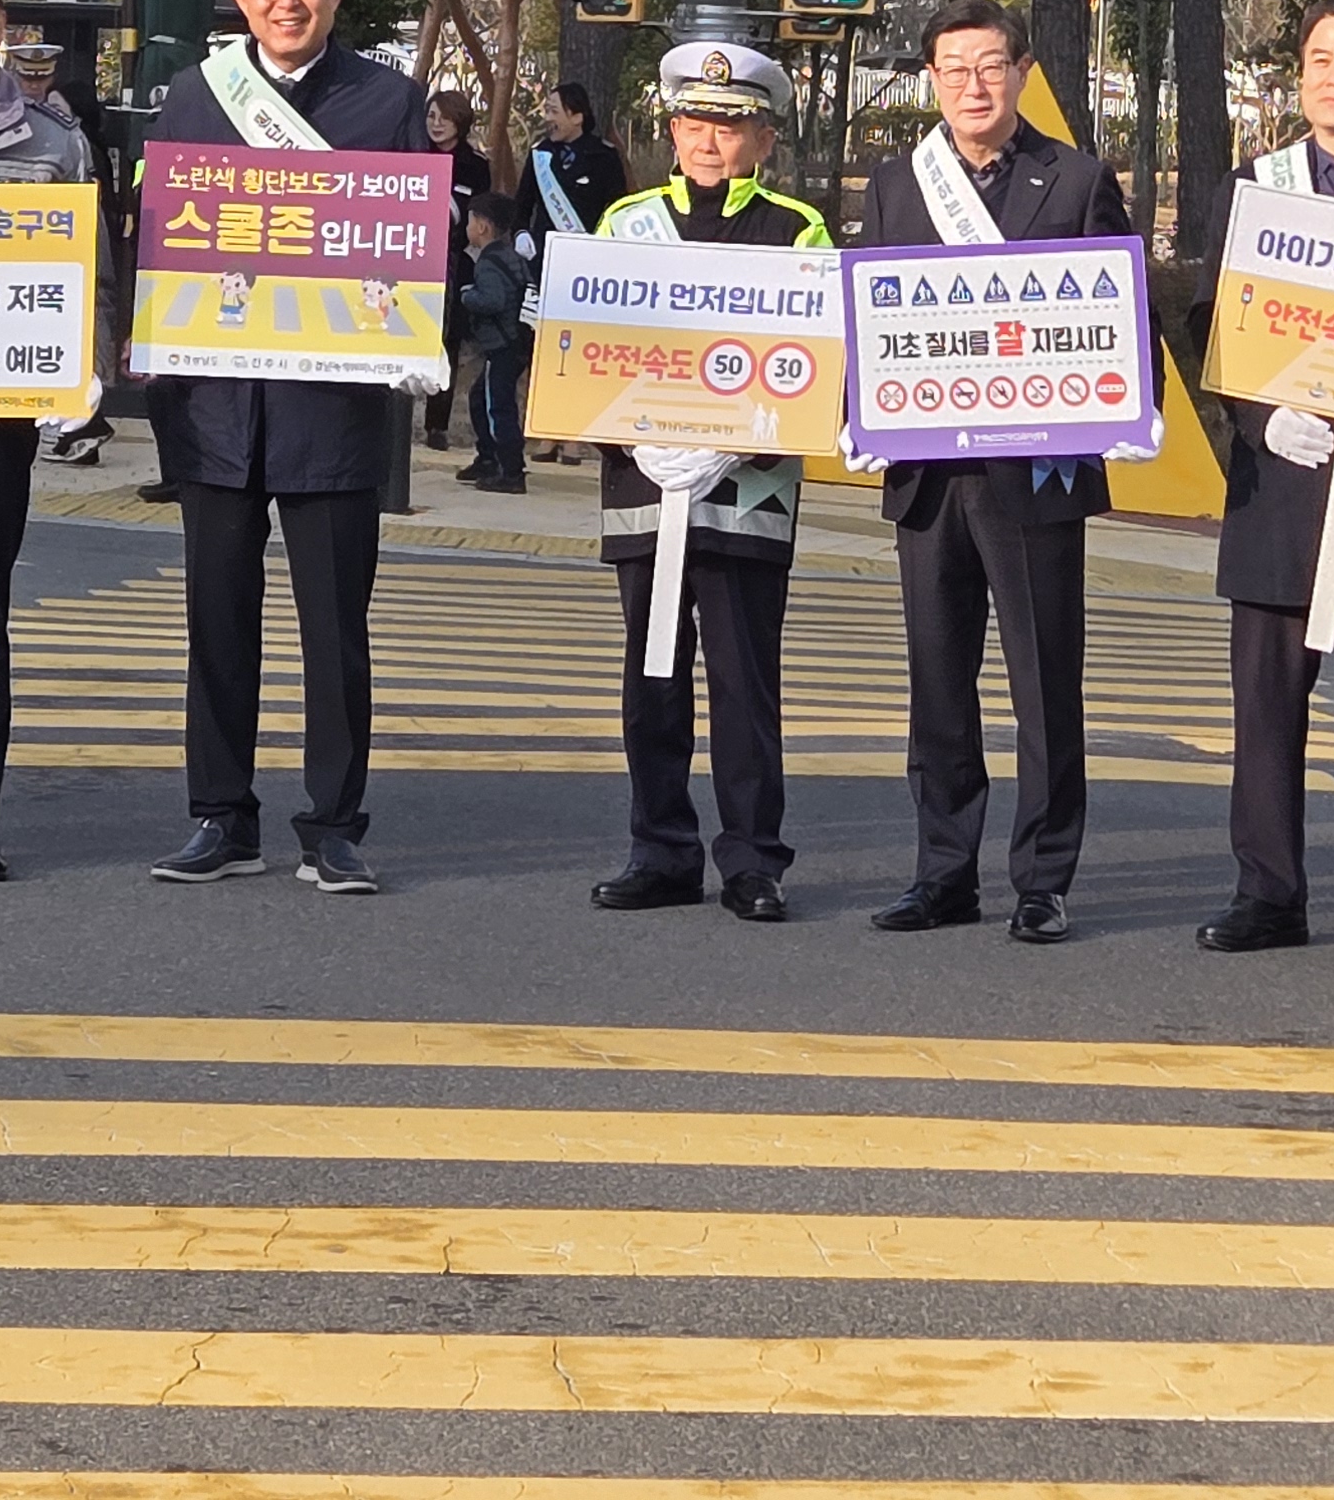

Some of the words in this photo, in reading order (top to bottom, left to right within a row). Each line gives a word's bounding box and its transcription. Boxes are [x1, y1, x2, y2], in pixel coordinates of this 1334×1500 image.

[165, 166, 236, 194] 노란색
[241, 168, 356, 199] 횡단보도가
[358, 173, 430, 202] 보이면
[7, 284, 65, 313] 저쪽
[571, 276, 661, 309] 아이가
[669, 283, 824, 318] 먼저입니다!
[879, 332, 921, 359] 기초
[925, 330, 990, 358] 질서를
[993, 320, 1026, 357] 잘
[1031, 324, 1118, 354] 지킵시다
[5, 344, 64, 374] 예방
[582, 342, 694, 381] 안전속도
[714, 354, 743, 376] 50
[773, 357, 803, 379] 30
